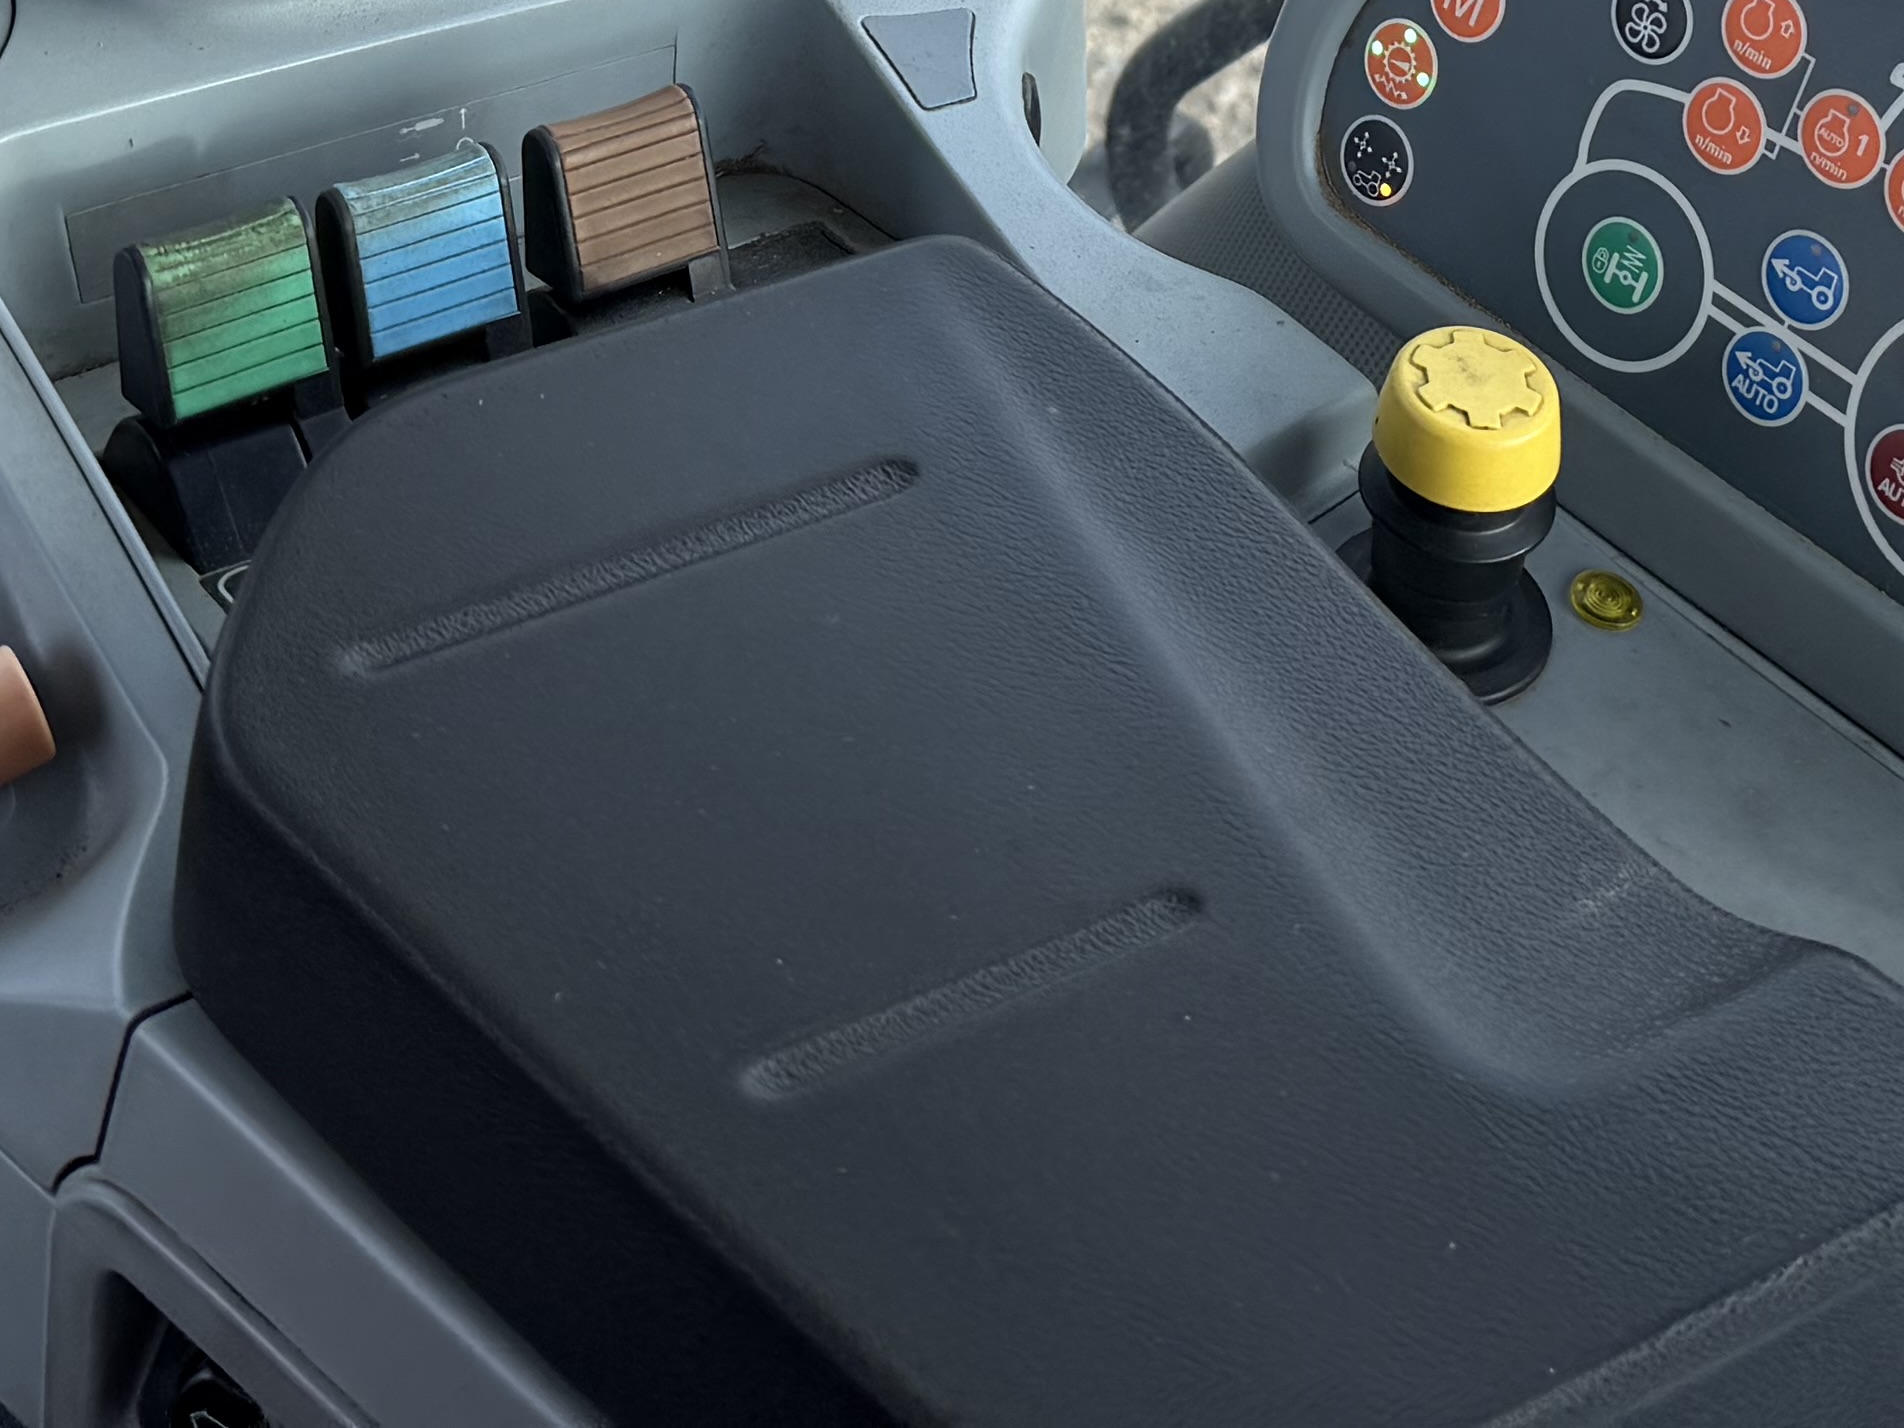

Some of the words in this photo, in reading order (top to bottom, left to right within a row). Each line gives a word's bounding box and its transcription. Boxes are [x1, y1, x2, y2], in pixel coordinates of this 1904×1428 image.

[1732, 38, 1772, 71] n/min
[1695, 133, 1733, 165] n/min
[1817, 126, 1845, 148] AUTO
[1856, 134, 1870, 157] 1
[1810, 150, 1848, 181] n/min
[1731, 374, 1780, 415] AUTO
